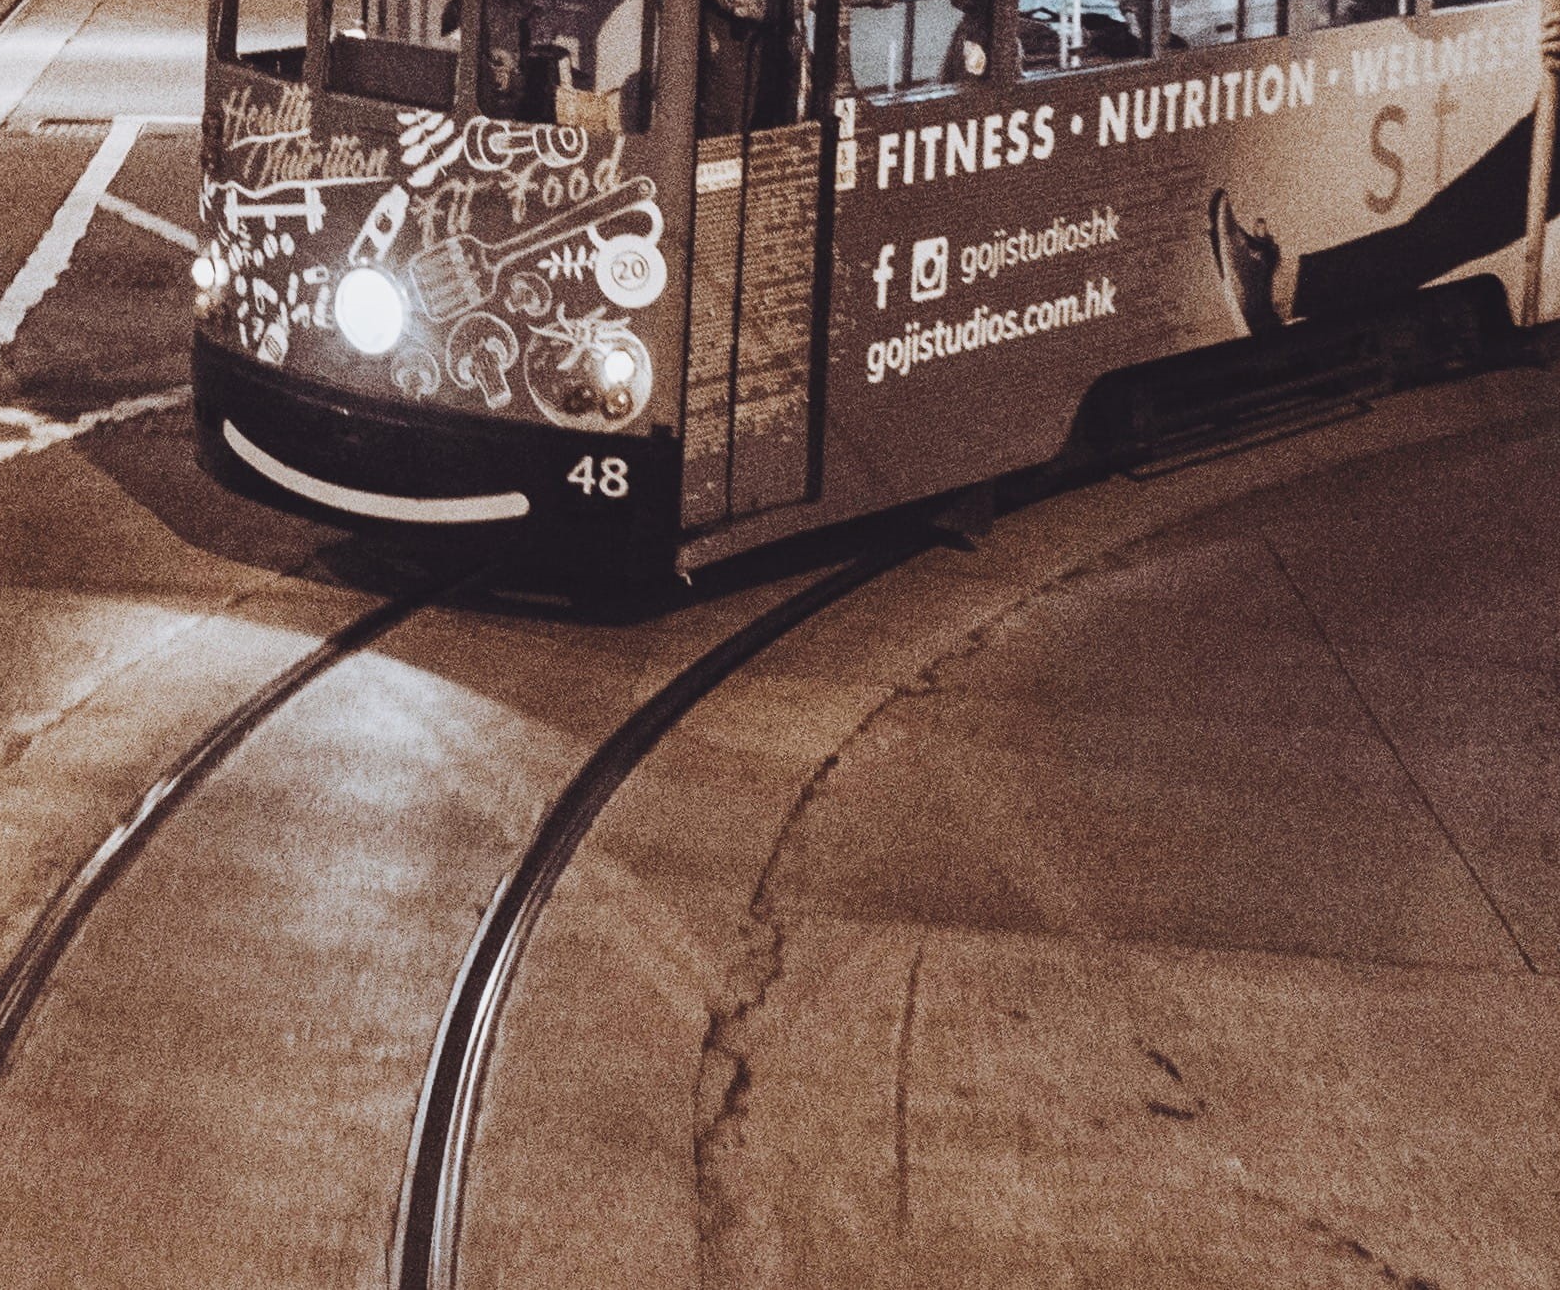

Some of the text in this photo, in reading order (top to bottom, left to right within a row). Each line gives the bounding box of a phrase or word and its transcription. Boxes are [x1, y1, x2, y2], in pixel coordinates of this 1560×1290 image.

[877, 105, 1056, 190] FITNESS
[1098, 59, 1315, 148] NUTRITION
[1350, 25, 1523, 97] WELLNESS
[612, 260, 646, 281] 20
[960, 206, 1121, 285] gojistudioshk
[866, 277, 1118, 384] gojistudios.com.hk
[566, 455, 629, 498] 48
